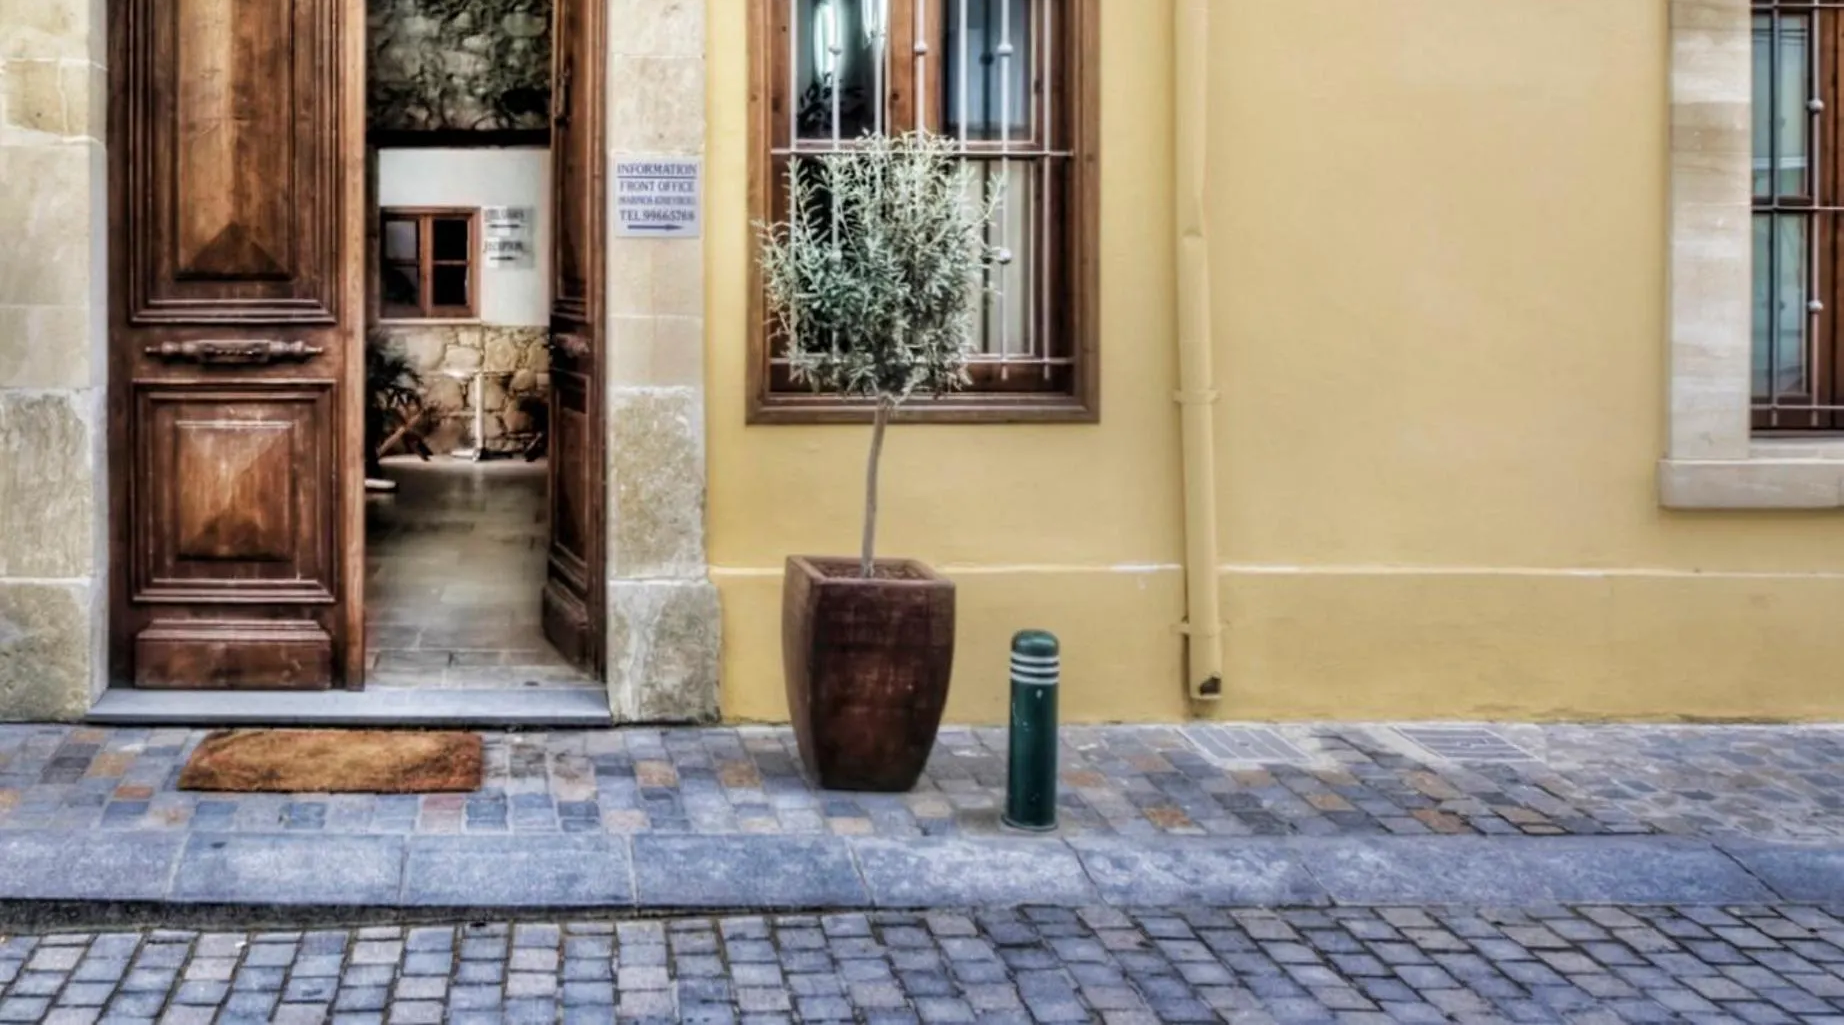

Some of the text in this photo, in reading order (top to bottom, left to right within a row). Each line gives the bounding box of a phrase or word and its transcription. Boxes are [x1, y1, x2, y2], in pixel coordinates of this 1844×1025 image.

[617, 163, 697, 175] INFORMATION
[620, 181, 695, 192] FRONT OFFICE
